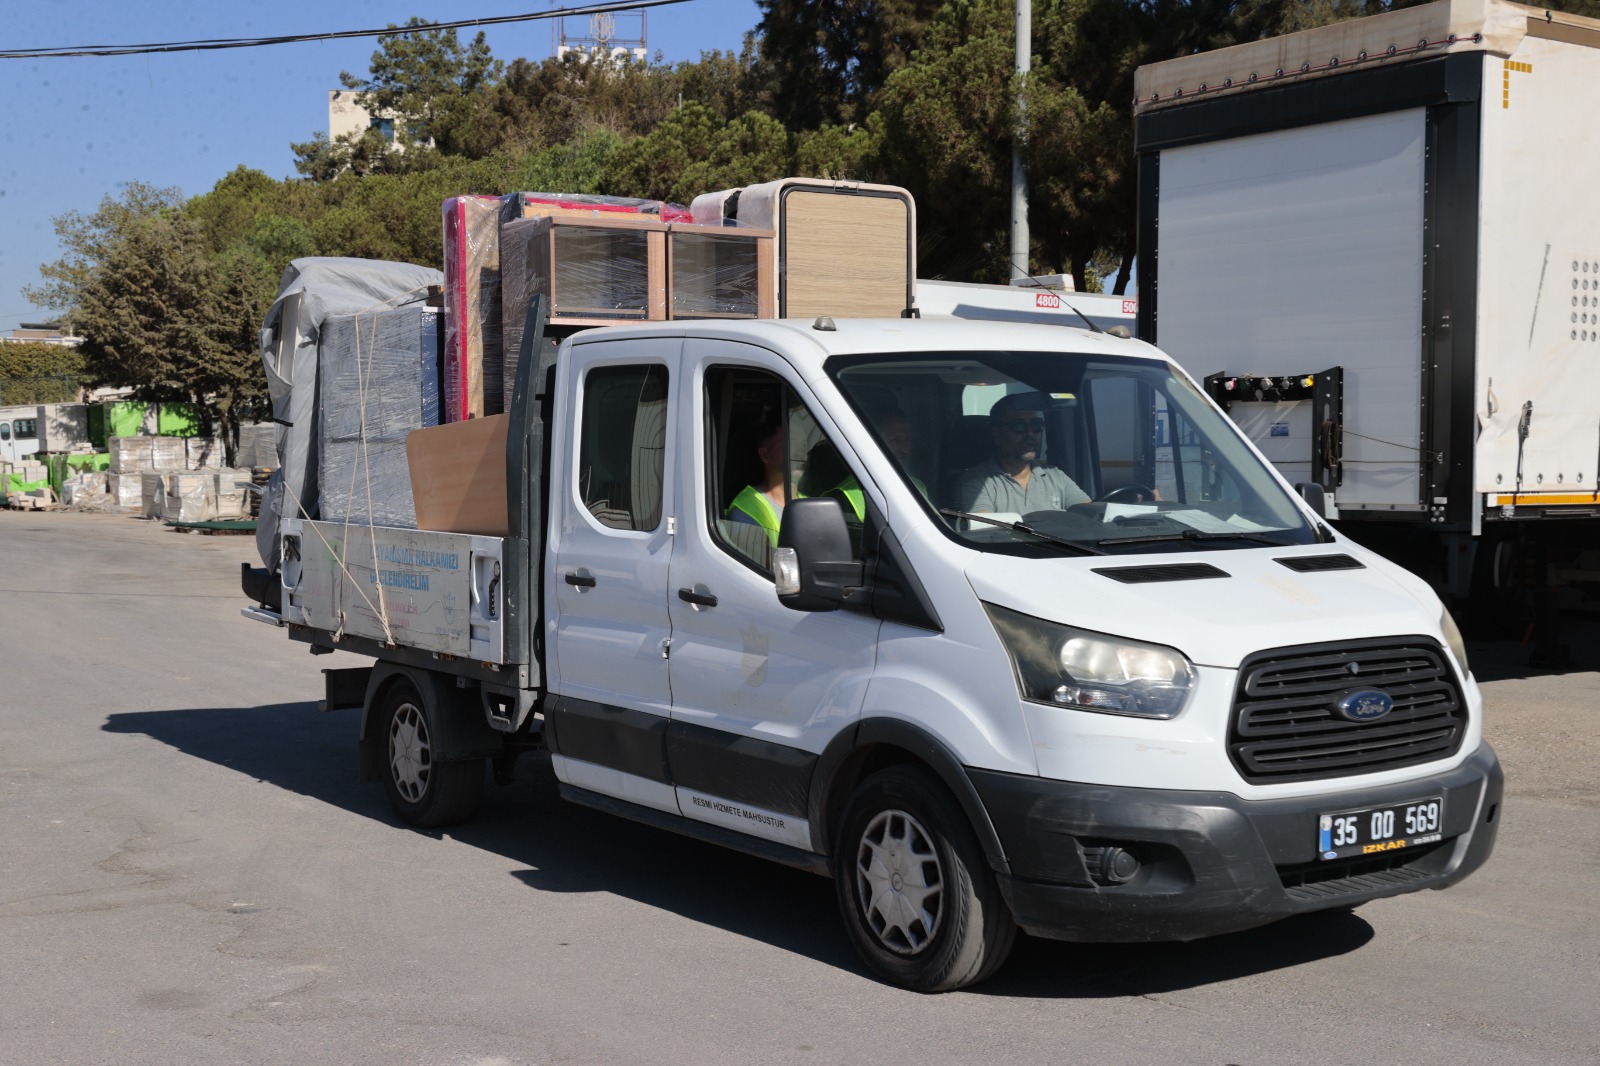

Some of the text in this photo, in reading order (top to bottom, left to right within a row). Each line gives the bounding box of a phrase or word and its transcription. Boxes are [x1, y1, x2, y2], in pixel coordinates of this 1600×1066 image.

[1037, 295, 1059, 307] 4800
[714, 801, 742, 817] HİZMETE
[742, 810, 785, 829] MAHSUSTUR
[1333, 803, 1438, 846] 35 DD 569
